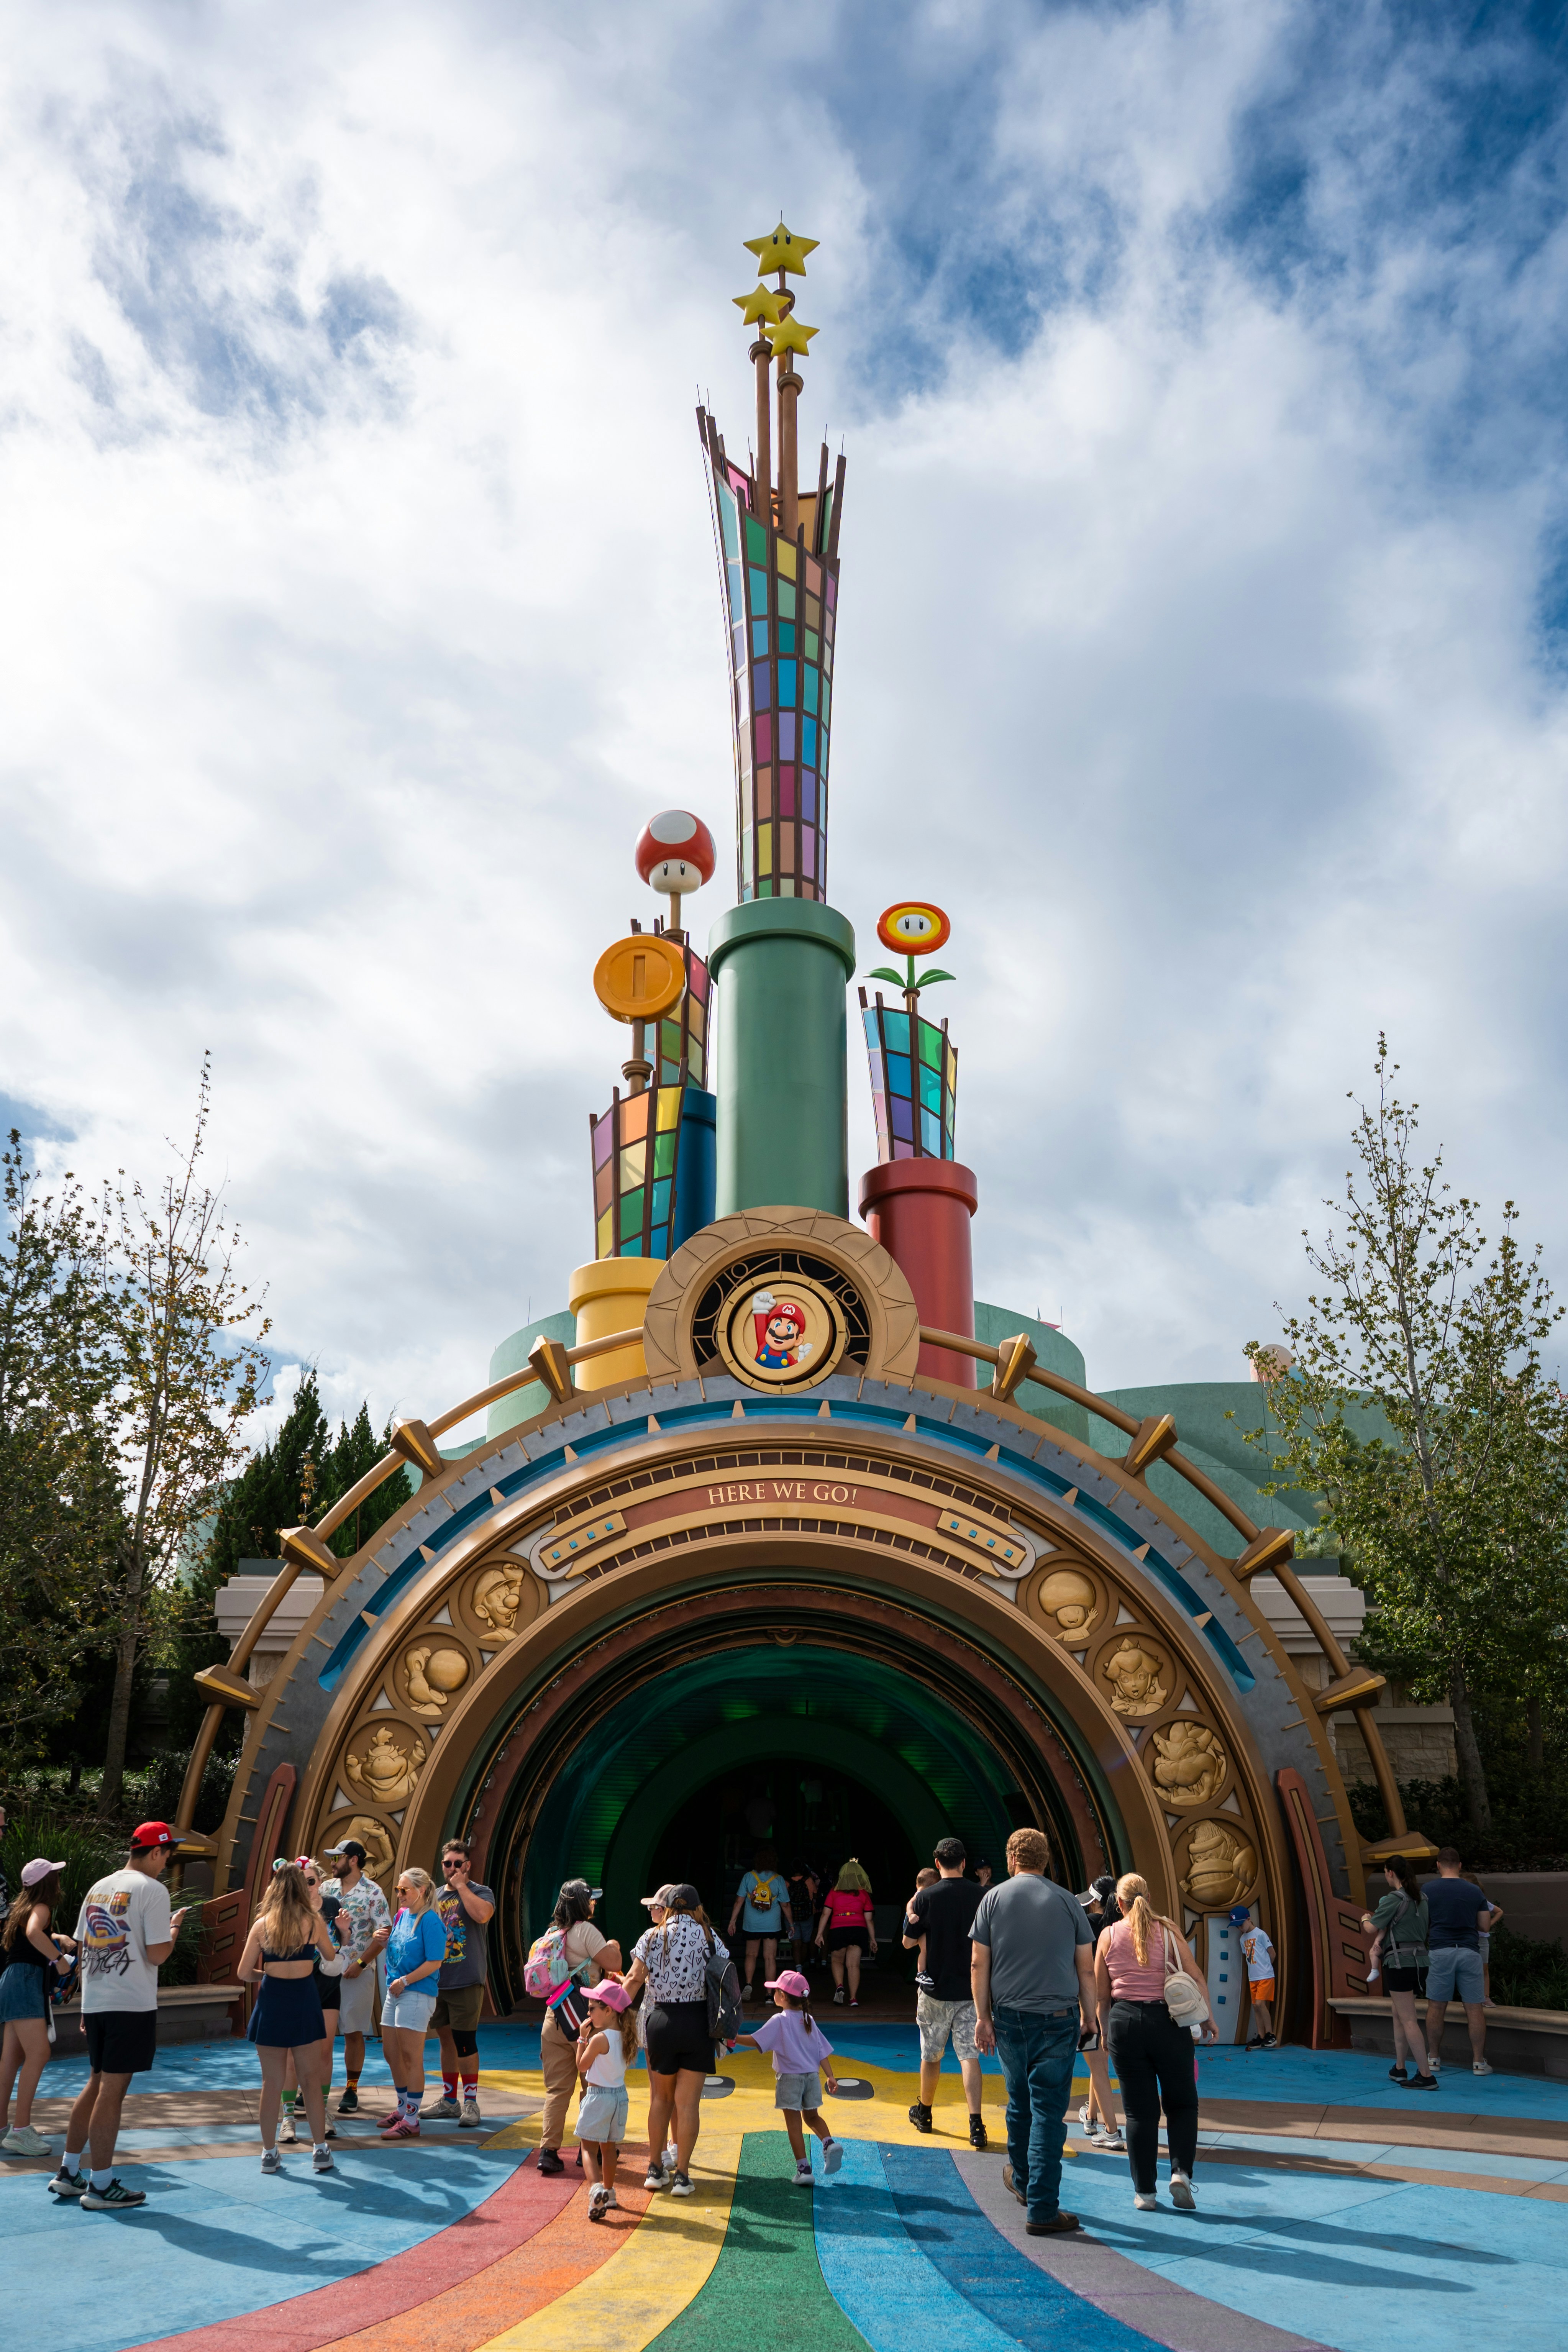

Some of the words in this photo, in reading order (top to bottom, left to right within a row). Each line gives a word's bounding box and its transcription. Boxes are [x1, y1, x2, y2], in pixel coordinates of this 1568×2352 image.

[707, 1483, 766, 1505] HERE
[772, 1483, 806, 1499] WE
[814, 1484, 857, 1504] GO!
[1244, 1938, 1256, 1949] JUST
[1245, 1948, 1255, 1957] DO
[464, 2085, 477, 2093] M
